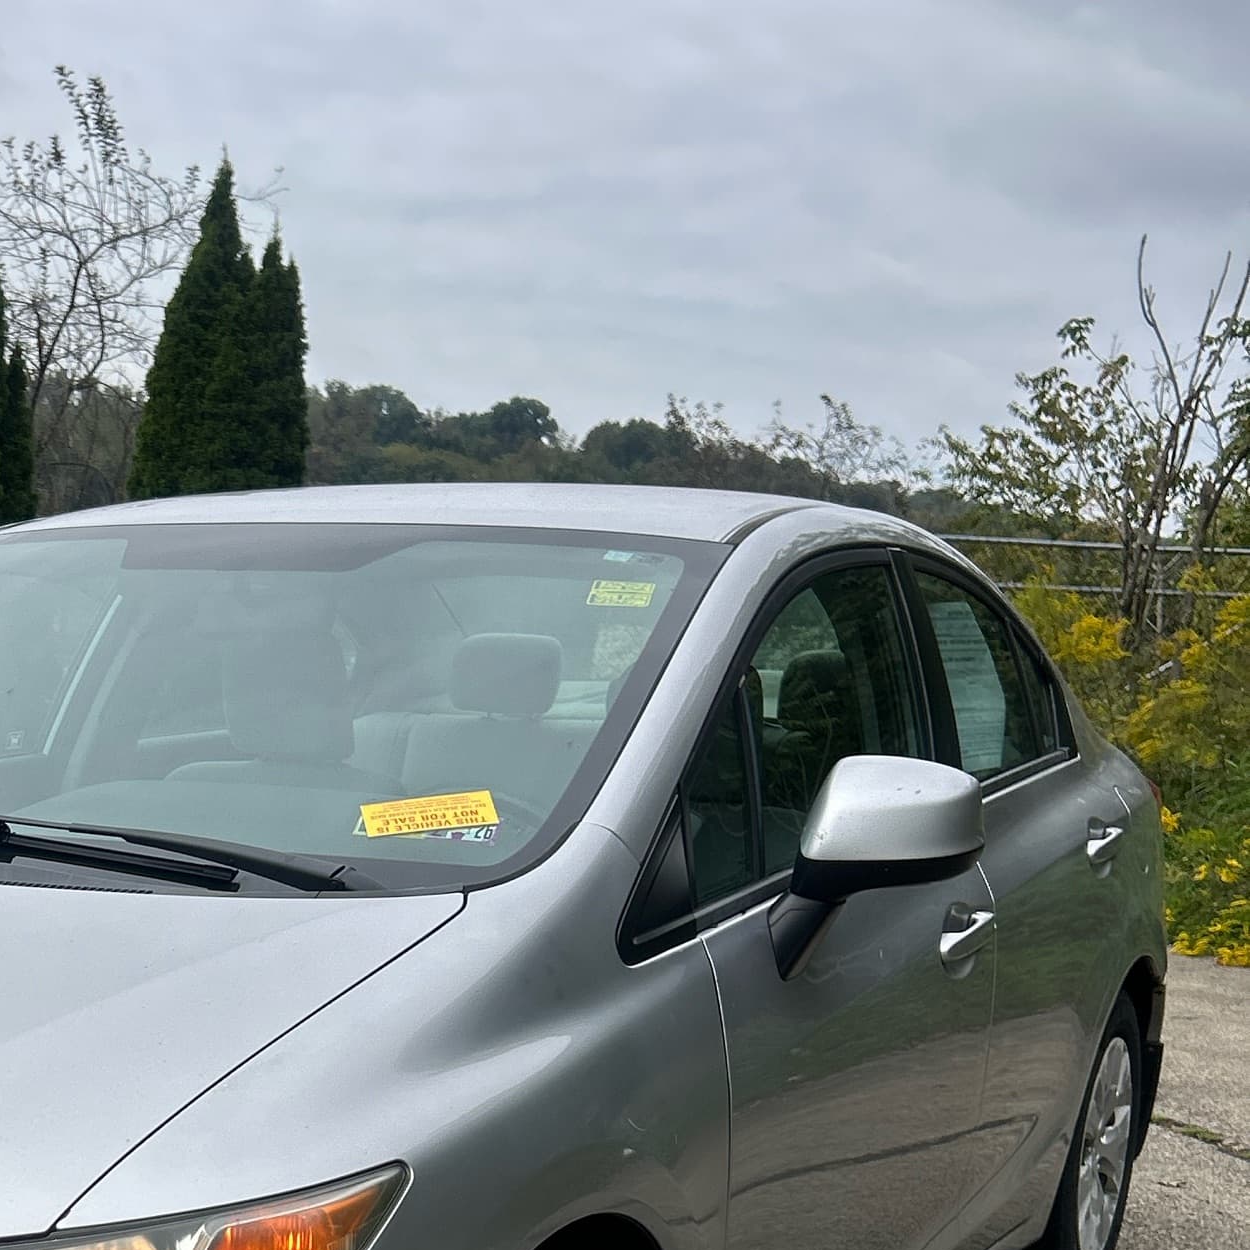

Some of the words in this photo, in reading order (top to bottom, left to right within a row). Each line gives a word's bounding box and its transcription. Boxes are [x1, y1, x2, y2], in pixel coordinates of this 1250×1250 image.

[420, 813, 447, 821] FOR
[453, 809, 479, 818] NOT
[381, 816, 415, 825] SALE
[455, 816, 487, 825] THIS
[394, 820, 452, 831] VEHICLE
